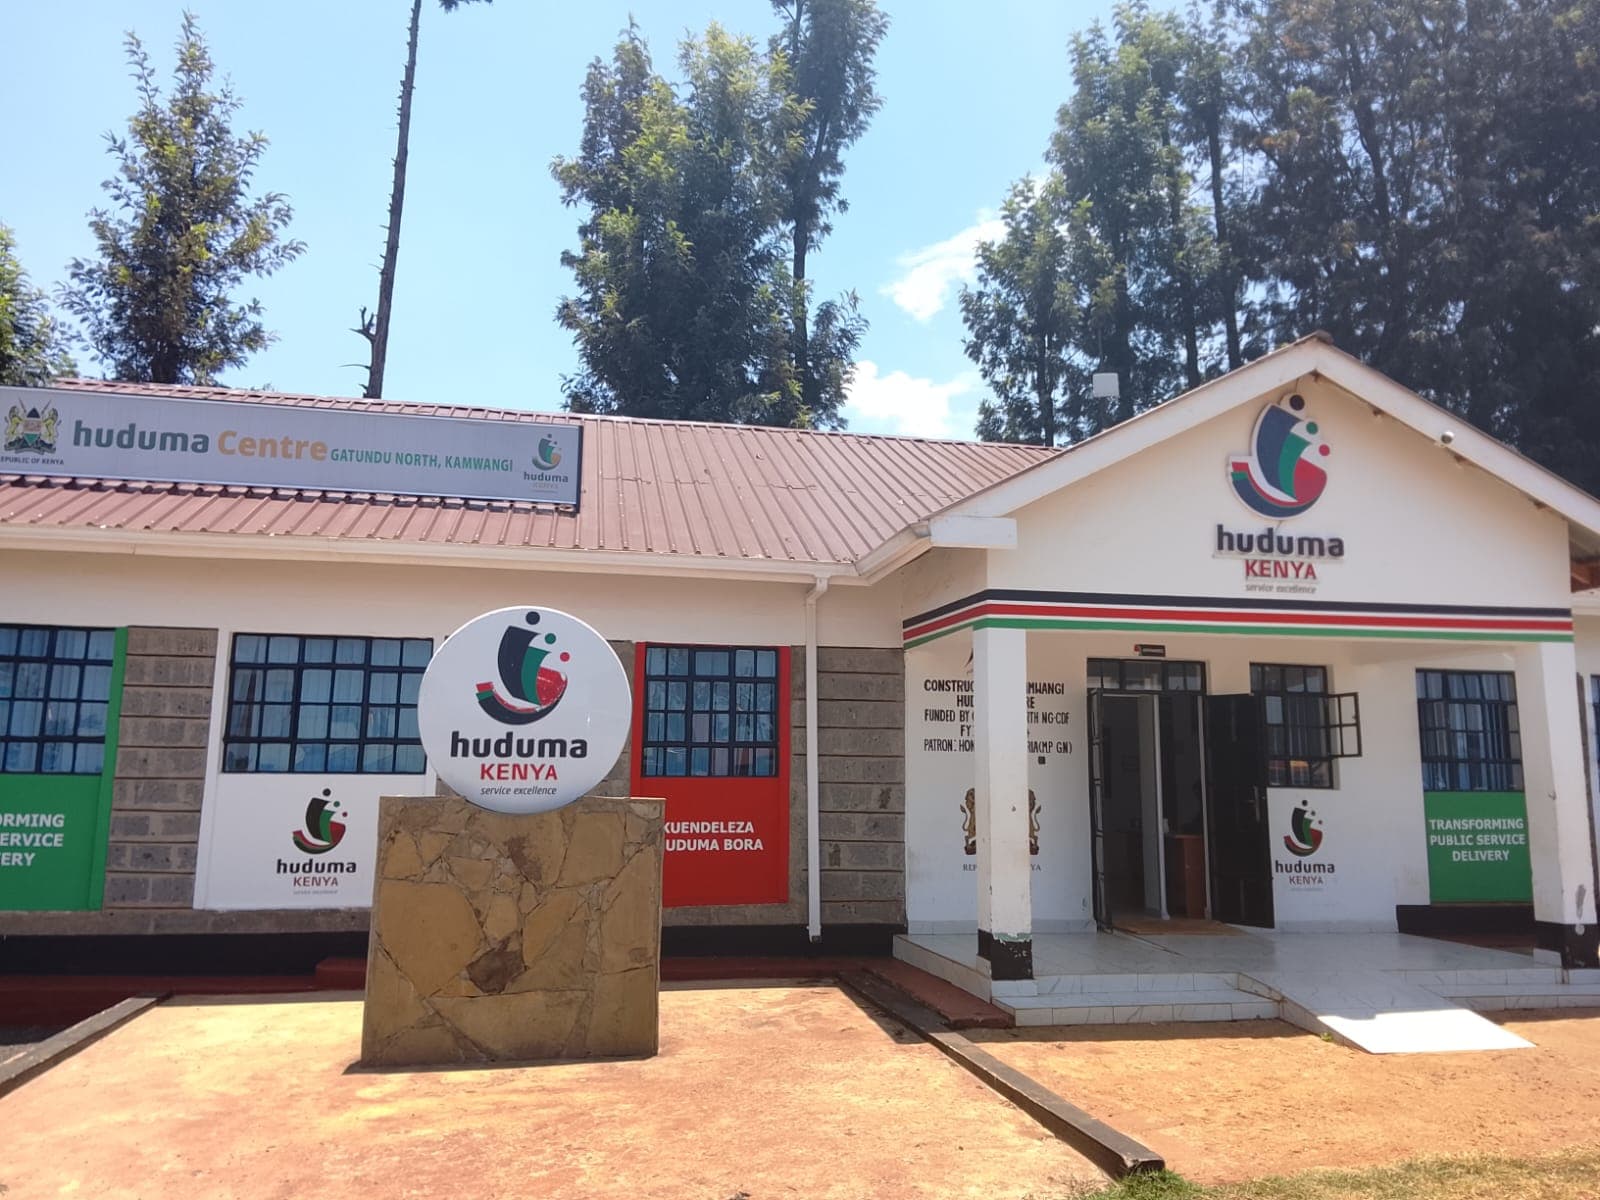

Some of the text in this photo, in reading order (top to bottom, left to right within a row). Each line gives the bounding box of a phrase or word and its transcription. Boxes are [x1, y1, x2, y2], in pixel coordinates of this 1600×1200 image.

[73, 419, 513, 472] huduma Centre GATUNDU NORTH, KAMWANGI
[523, 471, 569, 483] huduma
[1216, 524, 1345, 557] huduma
[1244, 559, 1317, 580] KENYA
[924, 709, 956, 722] FUNDED
[959, 710, 970, 722] BY
[960, 724, 971, 737] FY
[450, 731, 588, 758] huduma
[480, 763, 558, 780] KENYA
[480, 786, 557, 795] service excellence
[1429, 818, 1524, 831] TRANSFORMING
[665, 838, 764, 851] UDUMA BORA
[1430, 833, 1526, 846] PUBLIC SERVICE
[1451, 849, 1510, 862] DELIVERY
[276, 858, 357, 874] huduma
[1274, 860, 1336, 874] huduma
[293, 876, 338, 887] KENYA
[1288, 875, 1324, 886] KENYA
